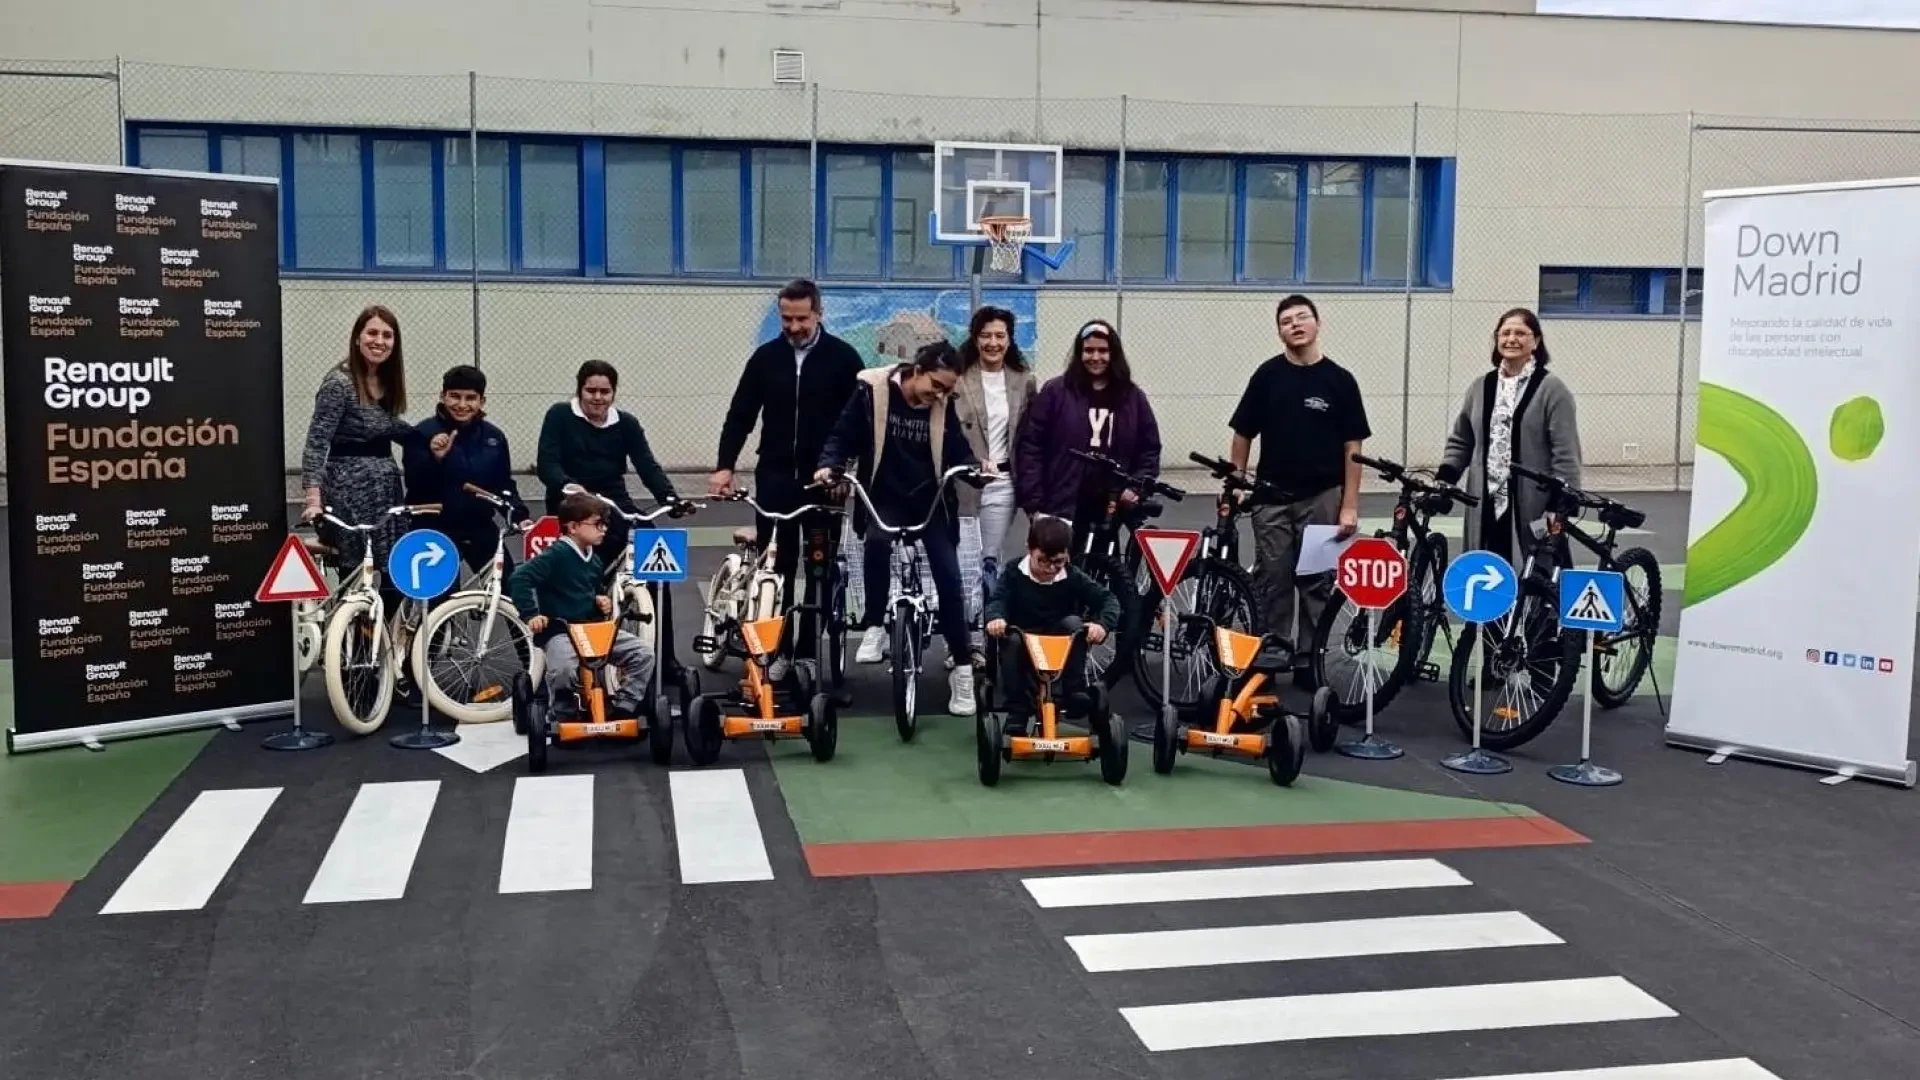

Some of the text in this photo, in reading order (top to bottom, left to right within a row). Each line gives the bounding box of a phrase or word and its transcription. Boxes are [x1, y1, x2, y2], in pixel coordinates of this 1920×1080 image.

[25, 188, 68, 200] Renault
[115, 193, 156, 205] Renault
[26, 198, 61, 209] Group
[115, 202, 149, 213] Group
[201, 199, 238, 210] Renault
[27, 209, 90, 222] Fundación
[201, 207, 232, 218] Group
[116, 214, 176, 226] Fundación
[202, 219, 257, 230] Fundación
[27, 220, 72, 232] España
[117, 224, 159, 236] España
[202, 229, 242, 240] España
[1737, 224, 1839, 258] Down
[73, 244, 113, 254] Renault
[161, 247, 200, 258] Renault
[73, 252, 106, 263] Group
[161, 255, 193, 266] Group
[74, 264, 136, 276] Fundación
[162, 268, 220, 279] Fundación
[75, 275, 118, 286] España
[162, 277, 203, 288] España
[1733, 258, 1862, 297] Madrid
[29, 296, 71, 306] Renault
[119, 297, 160, 307] Renault
[204, 300, 242, 309] Renault
[29, 304, 64, 315] Group
[120, 305, 153, 316] Group
[204, 307, 236, 317] Group
[30, 316, 92, 327] Fundación
[120, 317, 180, 327] Fundación
[205, 319, 261, 328] Fundación
[1850, 316, 1864, 327] de
[1868, 316, 1892, 327] vida
[30, 326, 76, 337] España
[121, 327, 163, 338] España
[205, 328, 246, 338] España
[44, 357, 174, 383] Renault
[44, 384, 150, 413] Group
[47, 417, 239, 450] Fundación
[47, 451, 187, 489] España
[126, 508, 166, 518] Renault
[212, 504, 248, 513] Renault
[36, 513, 78, 523] Renault
[126, 516, 159, 526] Group
[212, 511, 242, 521] Group
[36, 521, 70, 531] Group
[212, 521, 269, 533] Fundación
[37, 531, 99, 544] Fundación
[127, 527, 187, 538] Fundación
[213, 532, 252, 543] España
[127, 537, 170, 549] España
[37, 543, 80, 555] España
[83, 561, 124, 571] Renault
[171, 556, 210, 565] Renault
[171, 564, 203, 574] Group
[1344, 558, 1402, 589] STOP
[83, 570, 116, 580] Group
[172, 573, 229, 585] Fundación
[83, 579, 145, 591] Fundación
[172, 583, 214, 595] España
[84, 590, 128, 602] España
[215, 601, 252, 611] Renault
[129, 608, 169, 619] Renault
[215, 609, 245, 619] Group
[39, 616, 81, 627] Renault
[129, 616, 162, 627] Group
[216, 617, 272, 630] Fundación
[39, 624, 73, 635] Group
[130, 626, 190, 637] Fundación
[216, 629, 255, 641] España
[40, 635, 102, 647] Fundación
[130, 637, 172, 649] España
[41, 646, 84, 659] España
[174, 652, 213, 663] Renault
[86, 661, 127, 672] Renault
[174, 661, 206, 671] Group
[86, 670, 120, 681] Group
[175, 669, 233, 682] Fundación
[87, 678, 148, 692] Fundación
[175, 680, 216, 692] España
[87, 691, 131, 702] España
